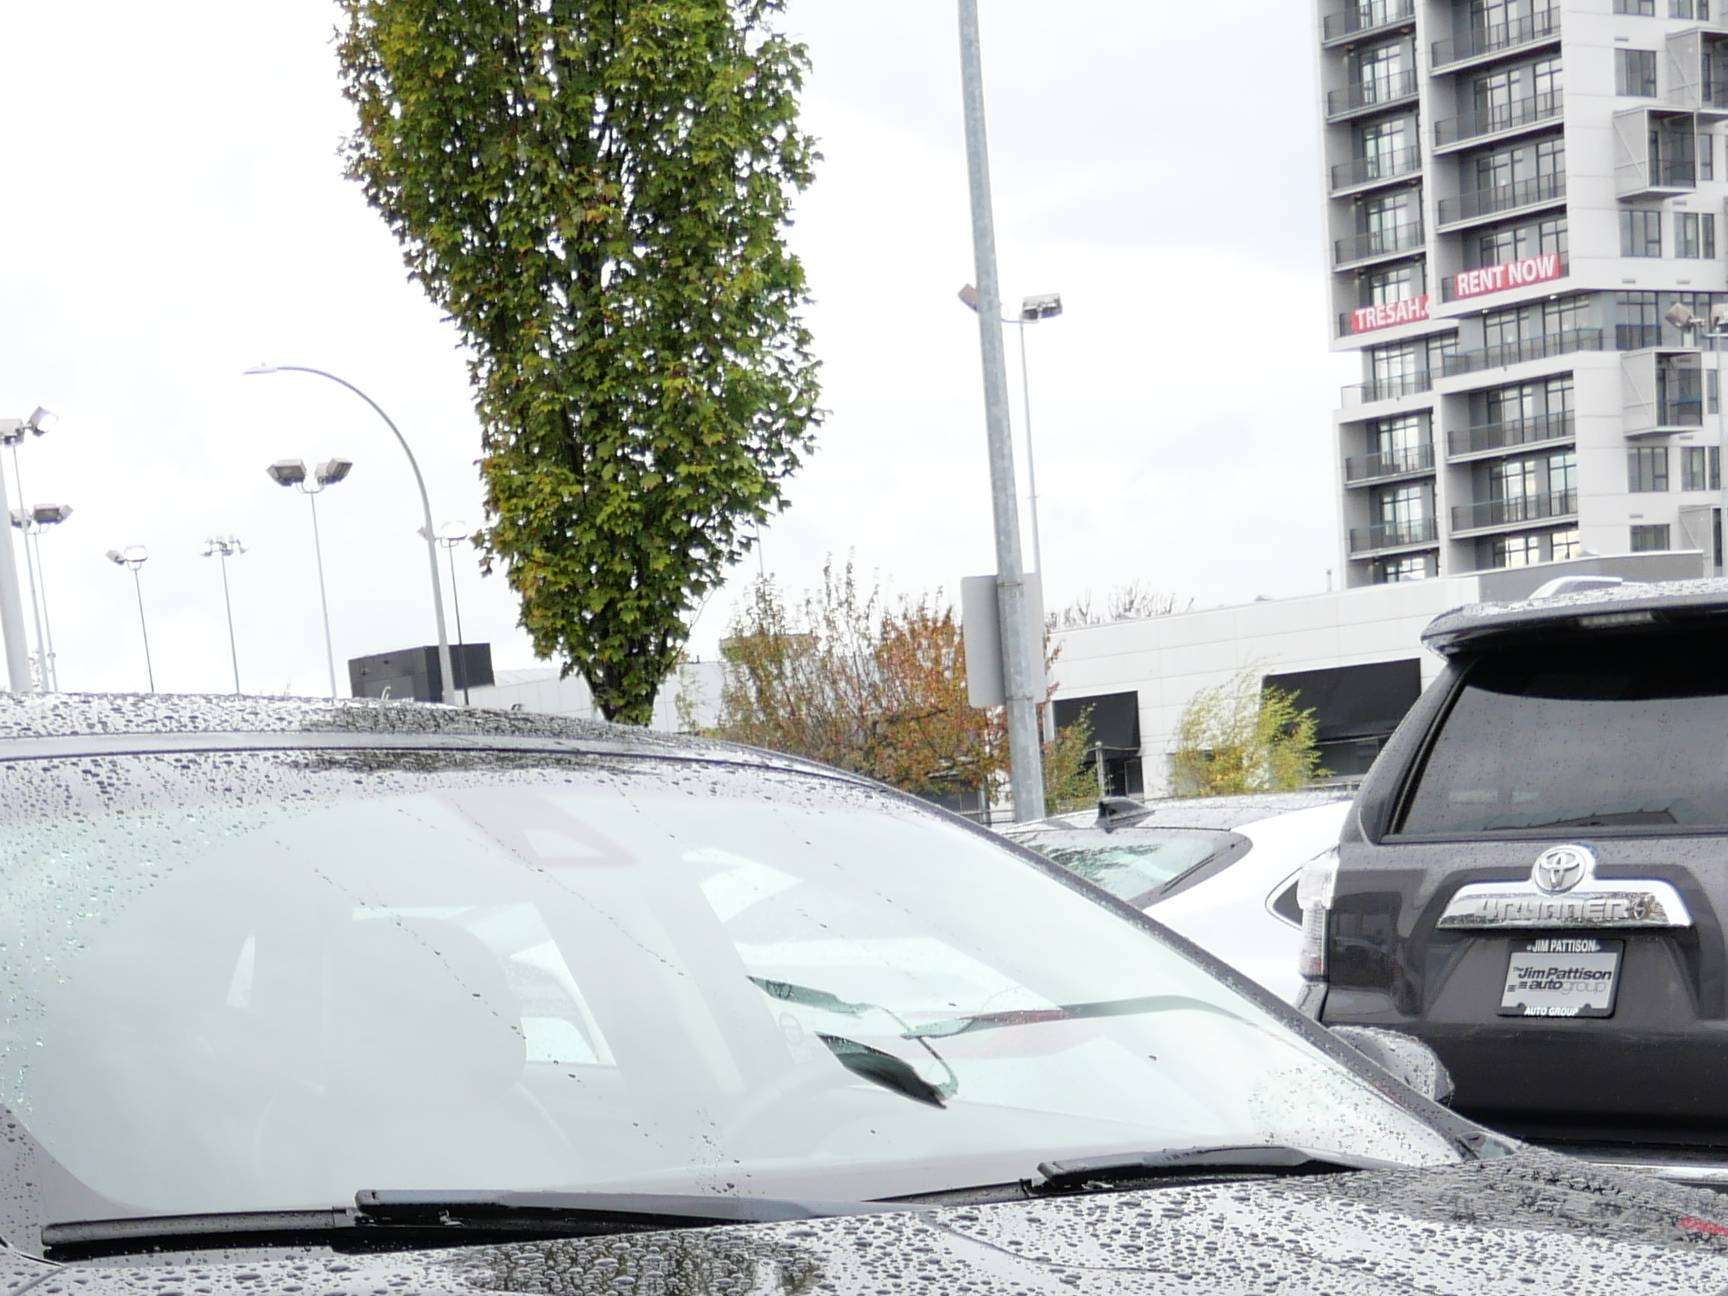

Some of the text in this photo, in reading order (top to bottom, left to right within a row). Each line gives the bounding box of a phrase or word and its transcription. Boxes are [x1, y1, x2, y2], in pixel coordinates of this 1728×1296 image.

[1457, 253, 1557, 296] RENT NOW
[1532, 939, 1597, 953] JIM PATTISON
[1545, 967, 1612, 981] Pattison
[1524, 1006, 1580, 1016] AUTO GROUP
